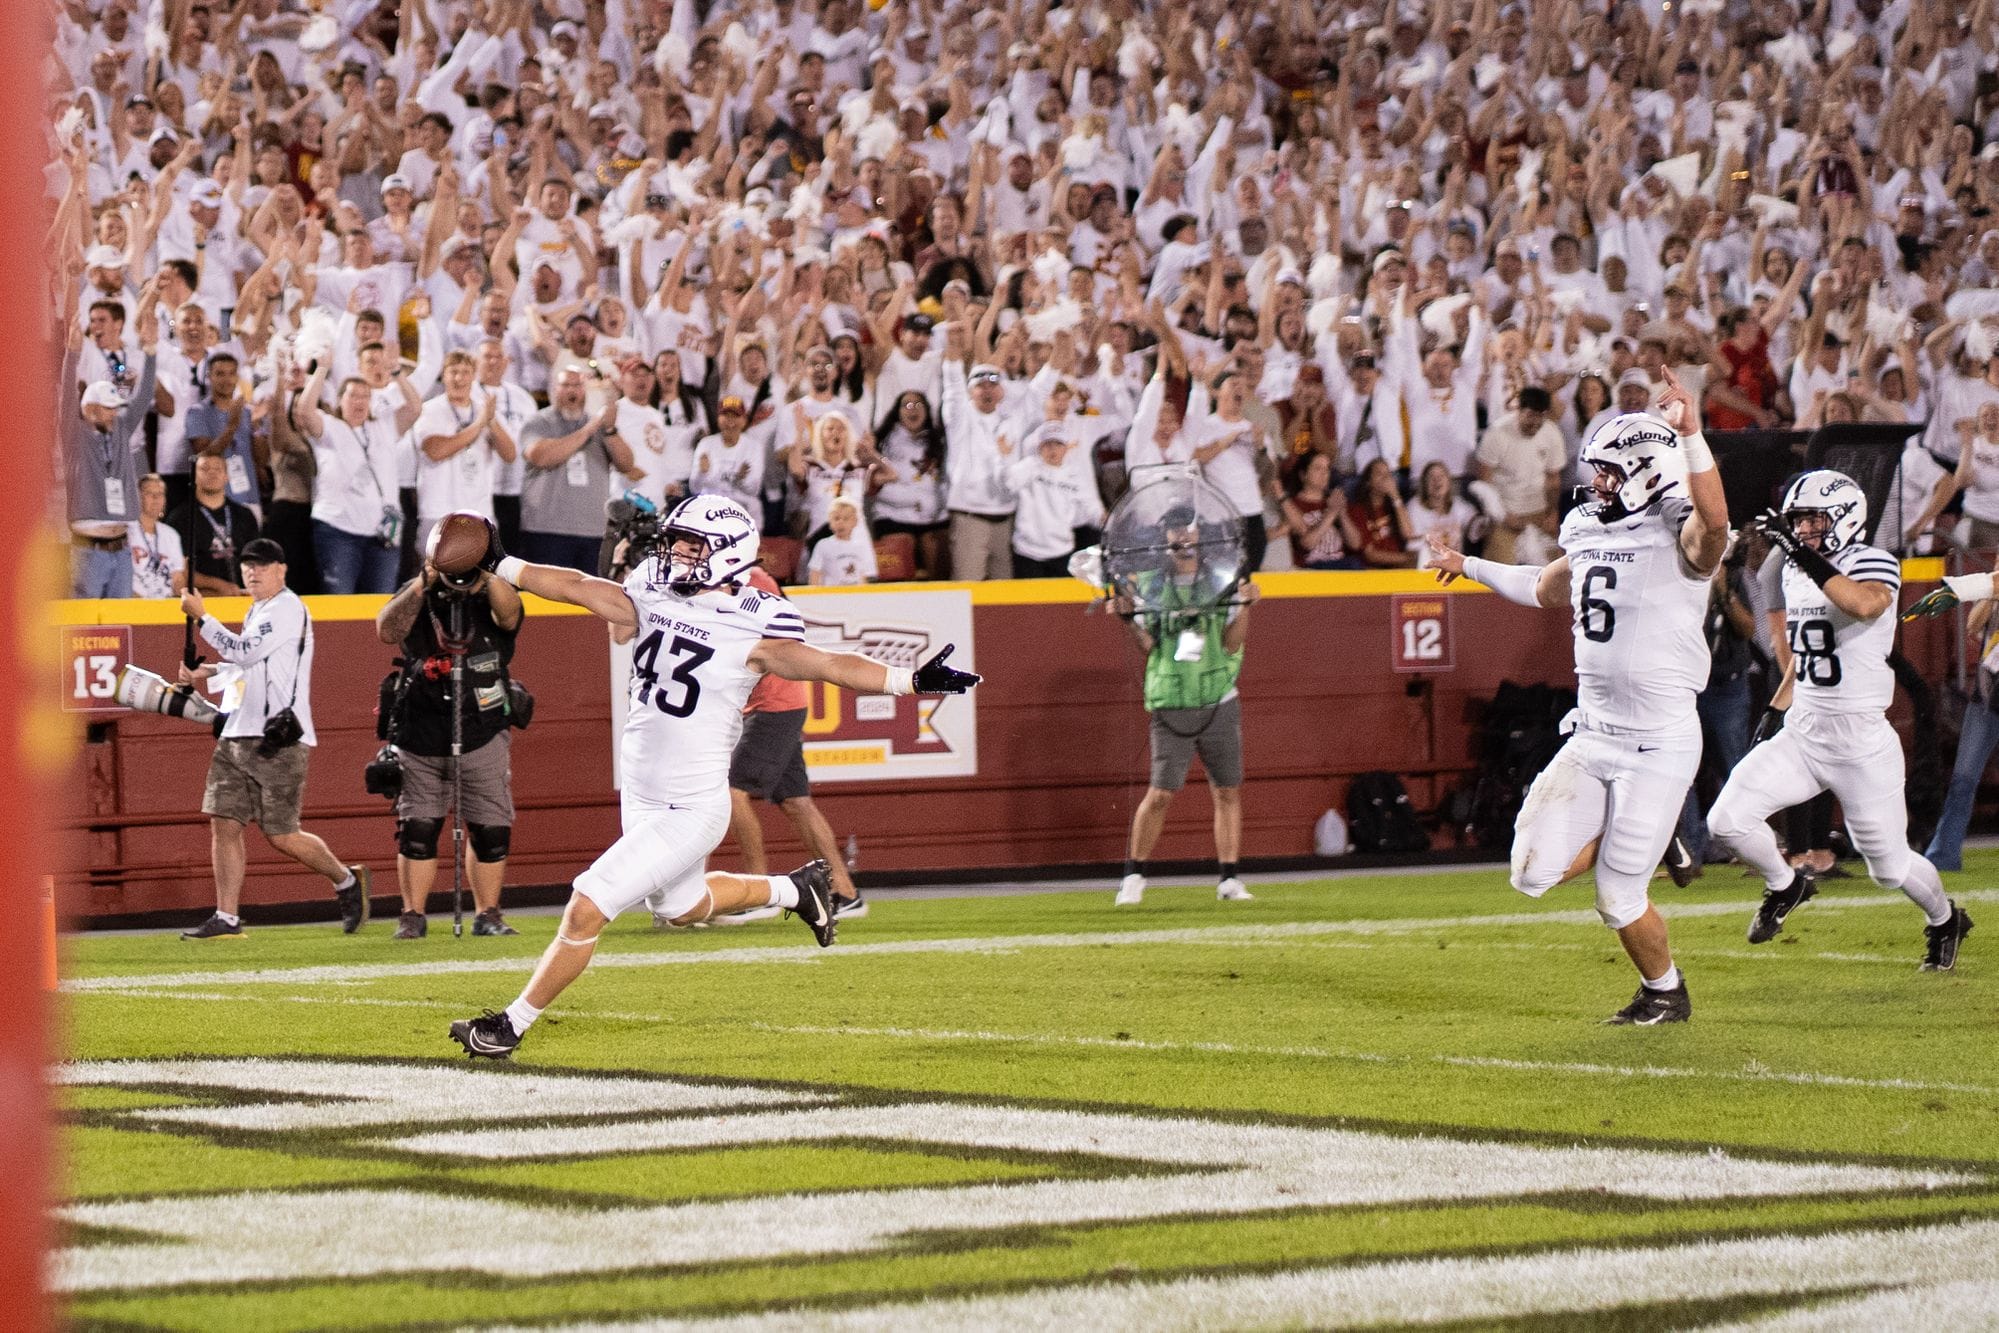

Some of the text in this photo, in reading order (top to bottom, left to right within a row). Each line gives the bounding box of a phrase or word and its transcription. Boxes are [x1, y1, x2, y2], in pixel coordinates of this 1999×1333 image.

[1602, 551, 1635, 562] STATE
[1580, 566, 1617, 643] 6
[72, 636, 121, 650] SECTION
[649, 612, 711, 641] IOWA STATE
[1403, 619, 1442, 660] 12
[73, 655, 117, 699] 13
[633, 629, 715, 718] 43
